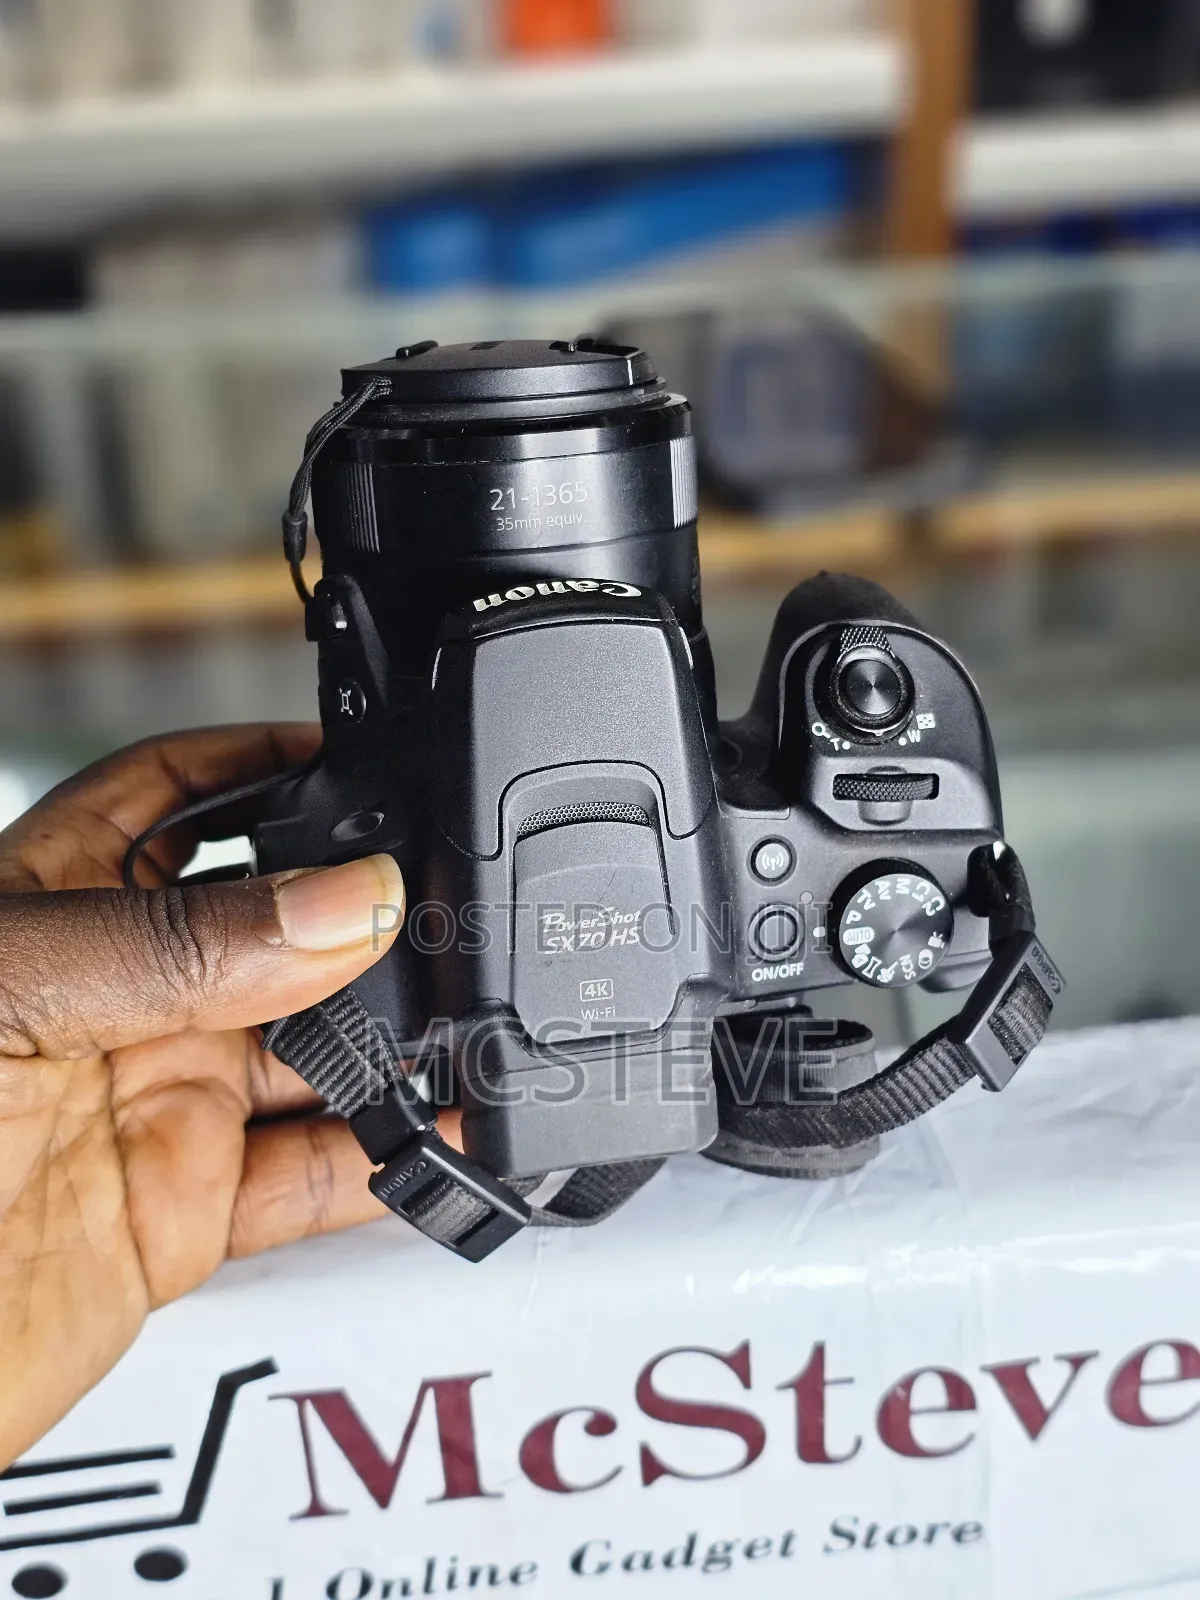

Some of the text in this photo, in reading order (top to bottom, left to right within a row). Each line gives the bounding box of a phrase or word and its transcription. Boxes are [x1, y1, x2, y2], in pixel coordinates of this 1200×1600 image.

[489, 481, 588, 511] 21-1365
[496, 516, 542, 532] 35mm
[473, 580, 642, 612] Canon
[540, 906, 642, 934] PowerShot
[609, 926, 642, 947] HS
[846, 929, 872, 944] AUTO
[751, 962, 804, 982] ON/OFF
[584, 981, 609, 998] 4K
[580, 1005, 616, 1021] Wi-Fi
[268, 1337, 1200, 1522] McSteve
[325, 1556, 538, 1600] Online
[569, 1530, 796, 1574] Gadget
[822, 1514, 983, 1554] Store
